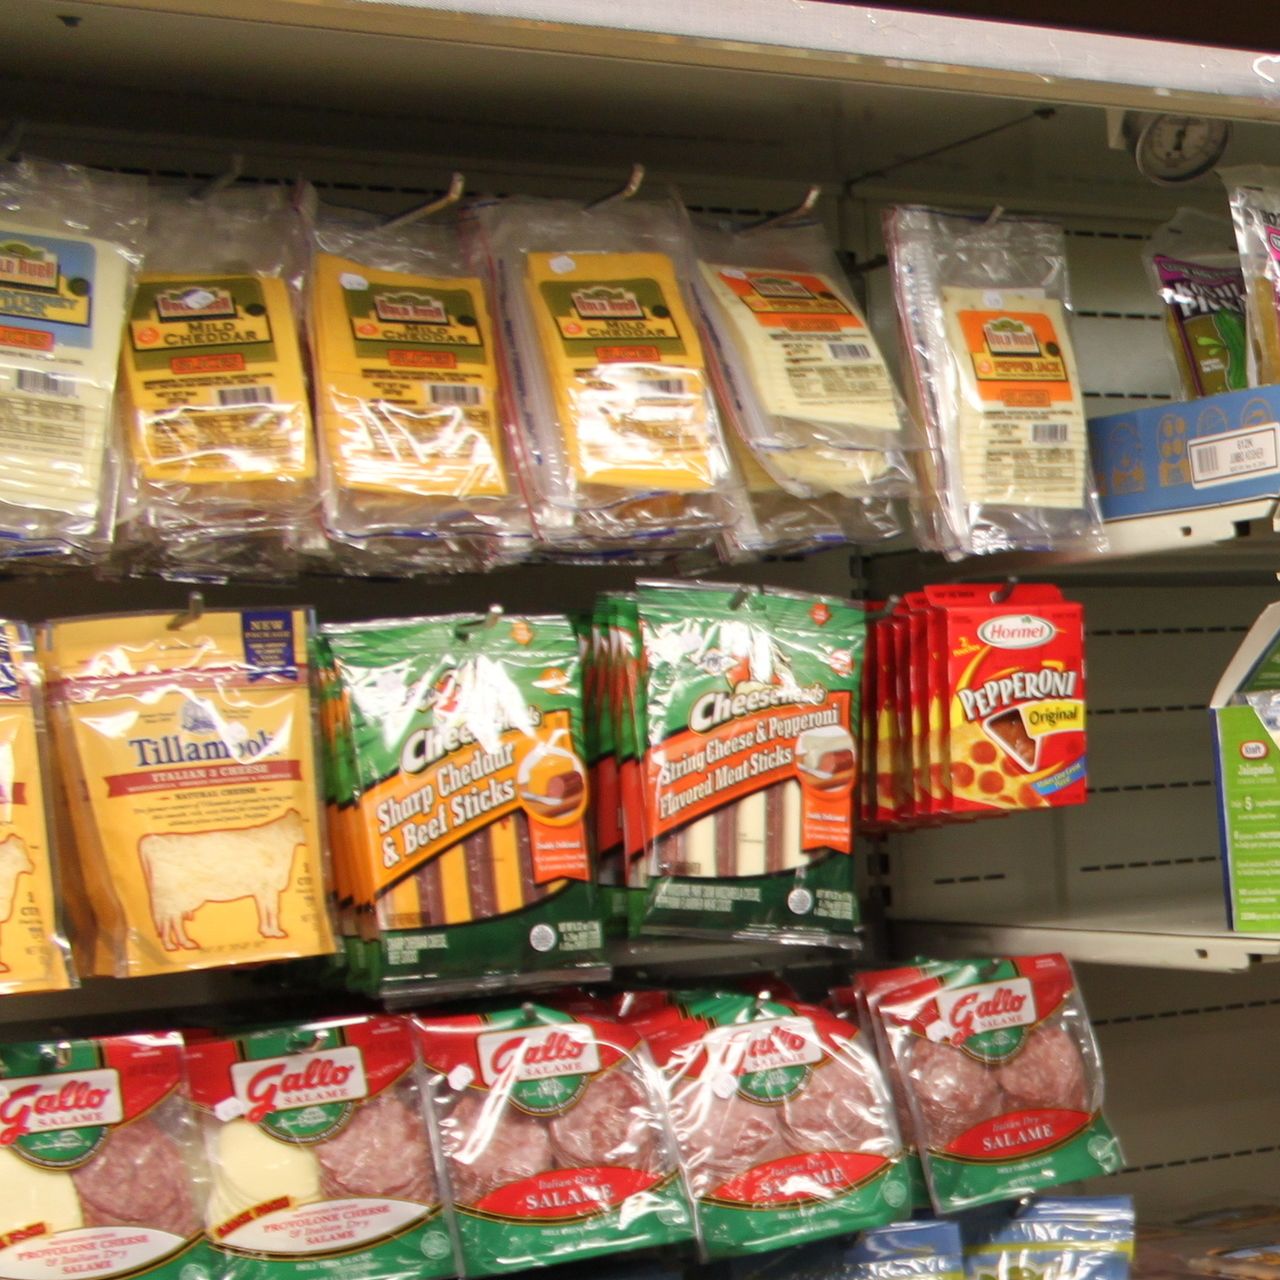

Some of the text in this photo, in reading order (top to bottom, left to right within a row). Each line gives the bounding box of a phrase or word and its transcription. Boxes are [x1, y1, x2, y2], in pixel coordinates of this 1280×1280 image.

[188, 322, 235, 333] MILD
[383, 330, 470, 344] CHEDDAR
[586, 327, 666, 339] CHEDDAR
[164, 331, 258, 346] CHEDDAR
[990, 623, 1046, 639] Hormel
[957, 667, 1078, 720] PEPPERONI
[1028, 706, 1078, 728] Original
[661, 703, 841, 787] String Cheese & Pepperoni
[1244, 744, 1263, 755] Kraft
[375, 741, 515, 835] Sharp Cheddar
[659, 746, 793, 819] Flavored Meat Sticks
[382, 778, 515, 869] & Beef Sticks
[949, 991, 1027, 1044] Gallo
[980, 1013, 1026, 1031] SALAME
[245, 1065, 355, 1122] Gallo
[282, 1087, 348, 1107] SALAME
[37, 1111, 105, 1131] SALAME
[981, 1123, 1055, 1153] SALAME
[262, 1214, 339, 1234] PROVOLONE
[340, 1204, 390, 1220] CHEESE
[17, 1232, 151, 1264] PROVOLONE CHEESE
[304, 1230, 357, 1246] SALAME
[61, 1259, 114, 1276] SALAME
